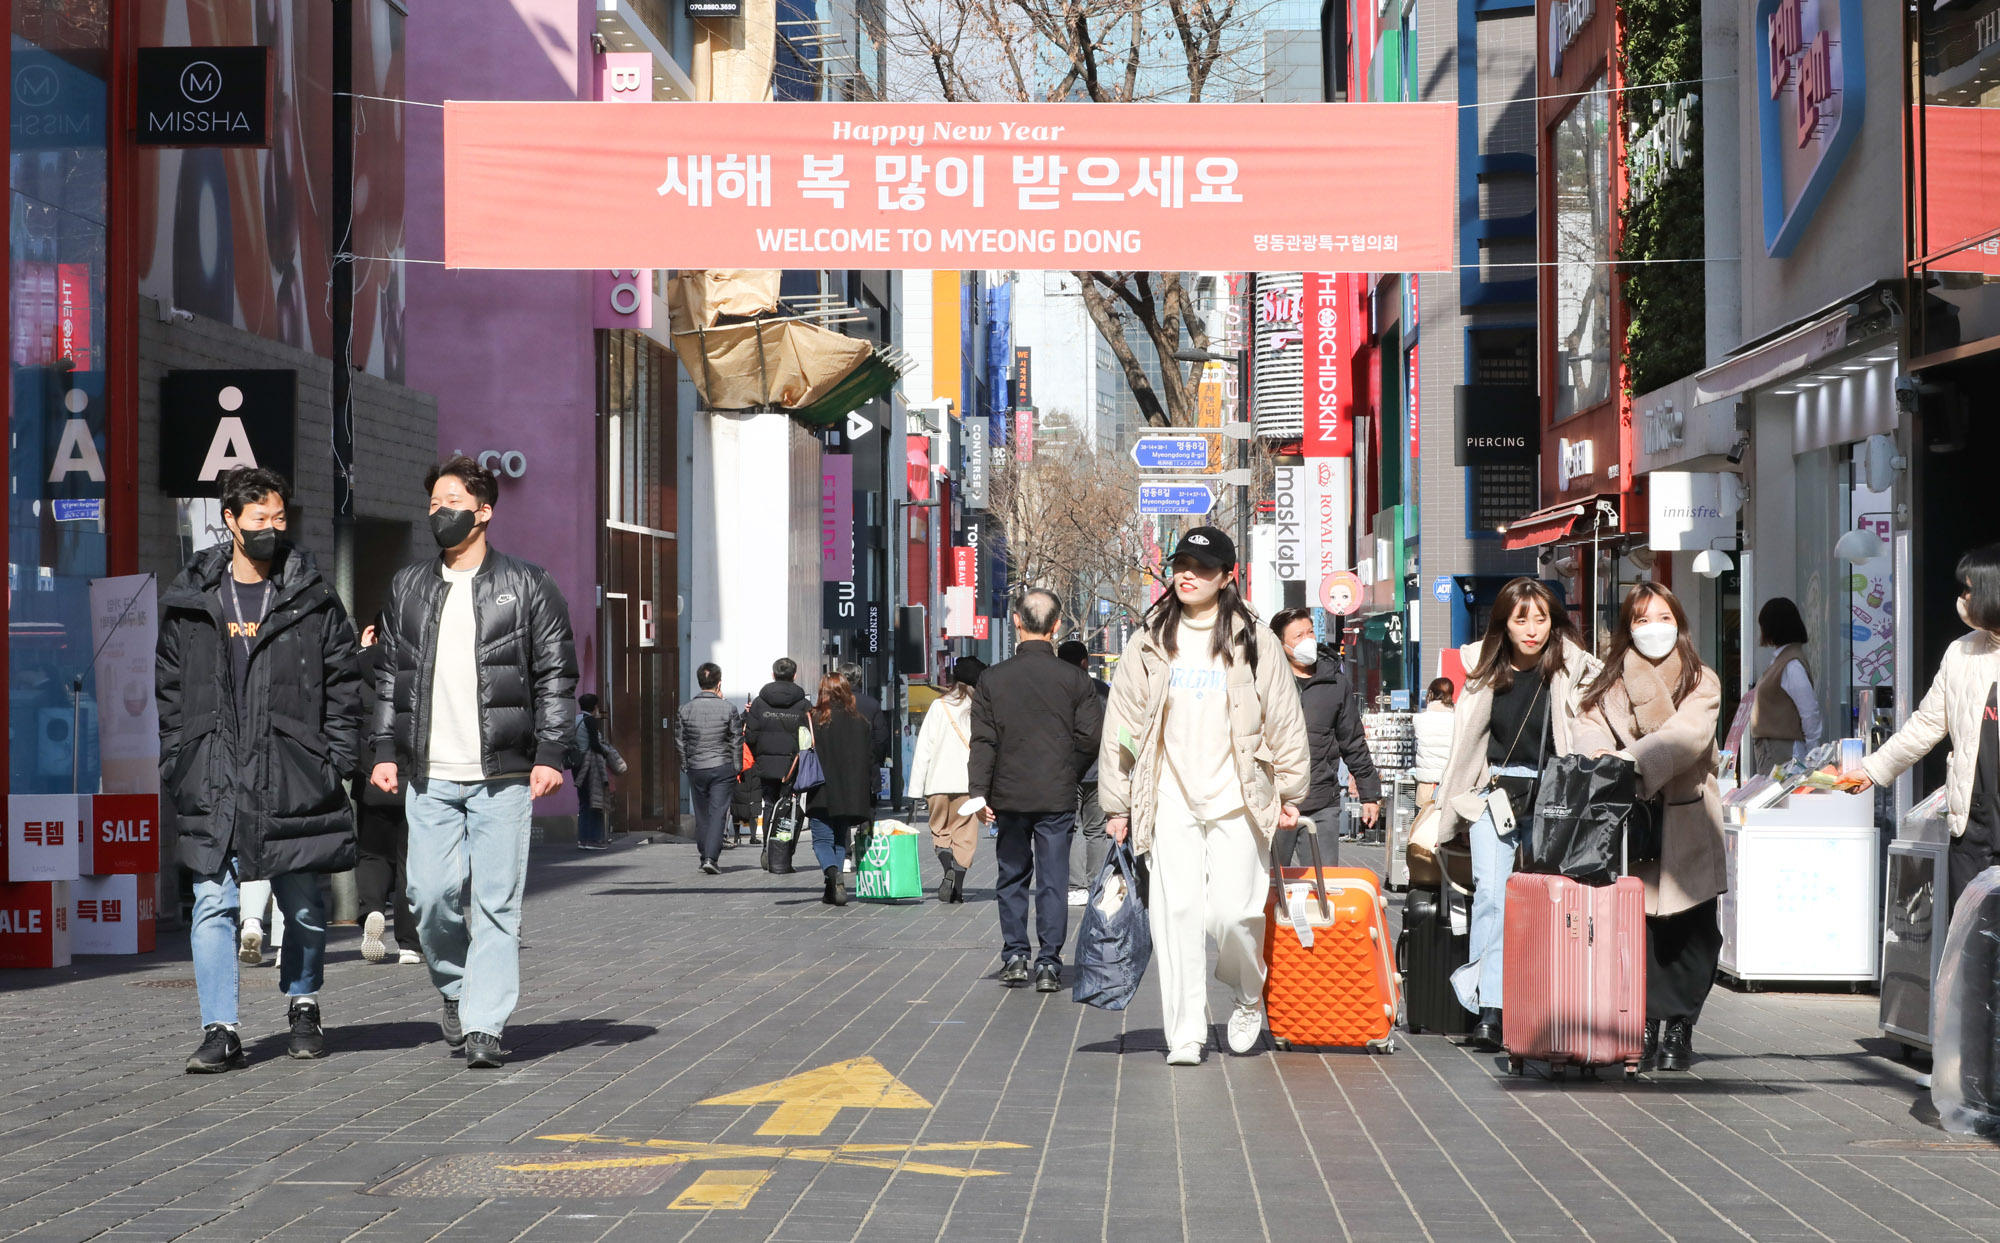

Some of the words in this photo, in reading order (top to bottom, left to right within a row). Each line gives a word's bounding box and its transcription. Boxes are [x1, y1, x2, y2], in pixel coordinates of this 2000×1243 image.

[1975, 8, 2000, 51] TH
[149, 111, 250, 132] MISSHA
[832, 121, 925, 146] Happy
[933, 121, 992, 141] New
[999, 121, 1066, 141] Year
[656, 153, 771, 207] 새해
[797, 154, 850, 209] 복
[875, 154, 984, 211] 많이
[1012, 155, 1243, 210] 받으세요
[756, 228, 890, 252] WELCOME
[897, 228, 932, 252] TO
[940, 228, 1056, 253] MYEONG
[1063, 229, 1142, 253] DONG
[1253, 234, 1398, 252] 명동관광특구협의회
[1177, 442, 1204, 451] 명동8길
[1467, 437, 1525, 447] PIERCING
[972, 424, 981, 488] CONVERSE
[1142, 488, 1170, 497] 명동8길
[1320, 494, 1333, 549] ROYAL
[1437, 584, 1451, 594] ADT
[869, 606, 878, 653] SKINFOOD
[24, 821, 64, 846] 득템
[102, 820, 150, 842] SALE
[77, 900, 121, 922] 득템
[139, 898, 153, 920] SALE
[0, 909, 42, 933] ALE
